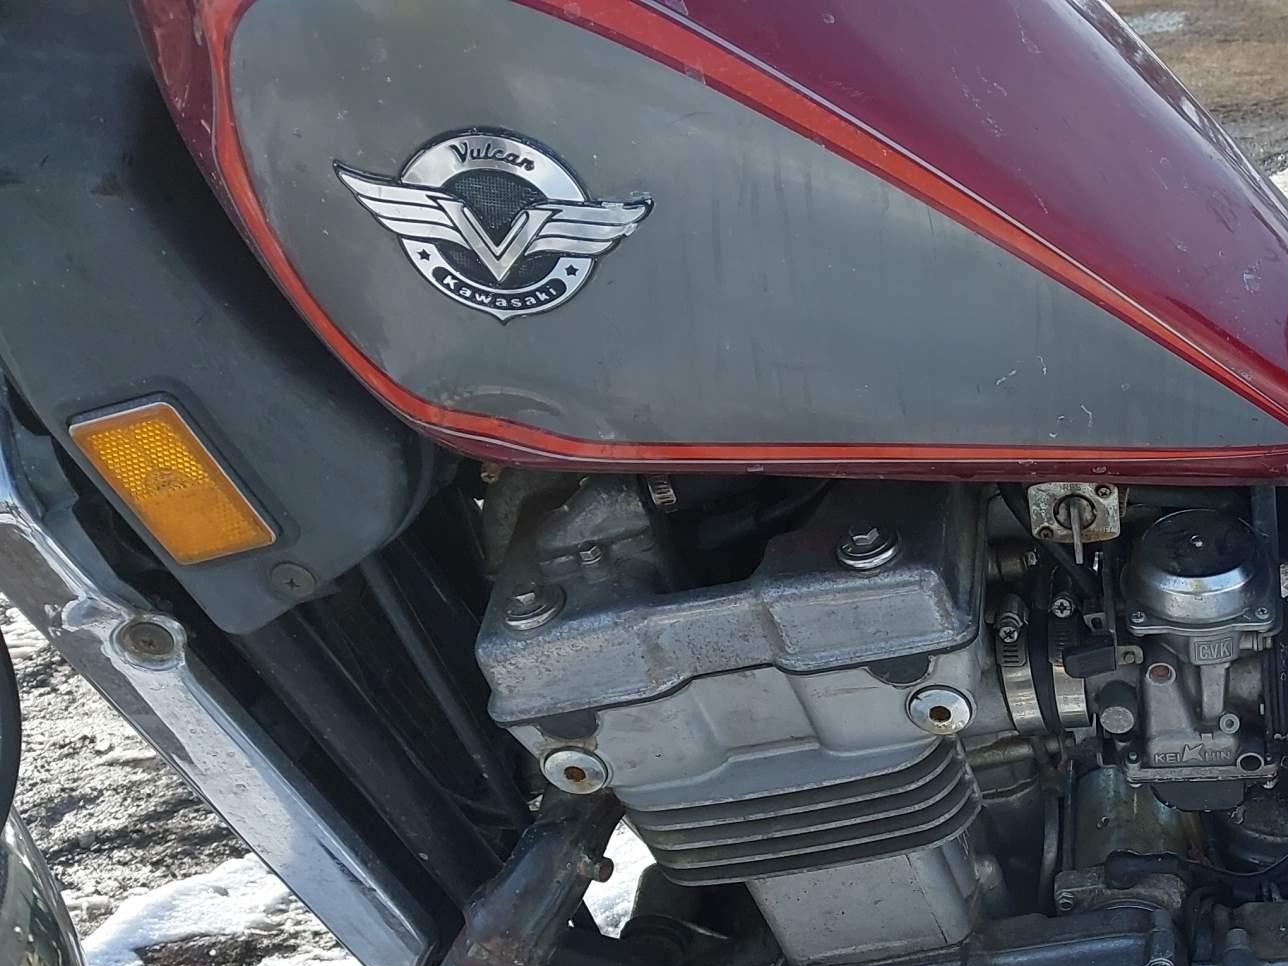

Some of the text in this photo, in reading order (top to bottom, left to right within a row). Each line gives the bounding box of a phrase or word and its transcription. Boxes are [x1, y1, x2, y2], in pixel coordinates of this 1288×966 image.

[449, 141, 536, 172] Vulcan
[442, 274, 557, 308] Kawasaki
[1199, 641, 1231, 660] CVK
